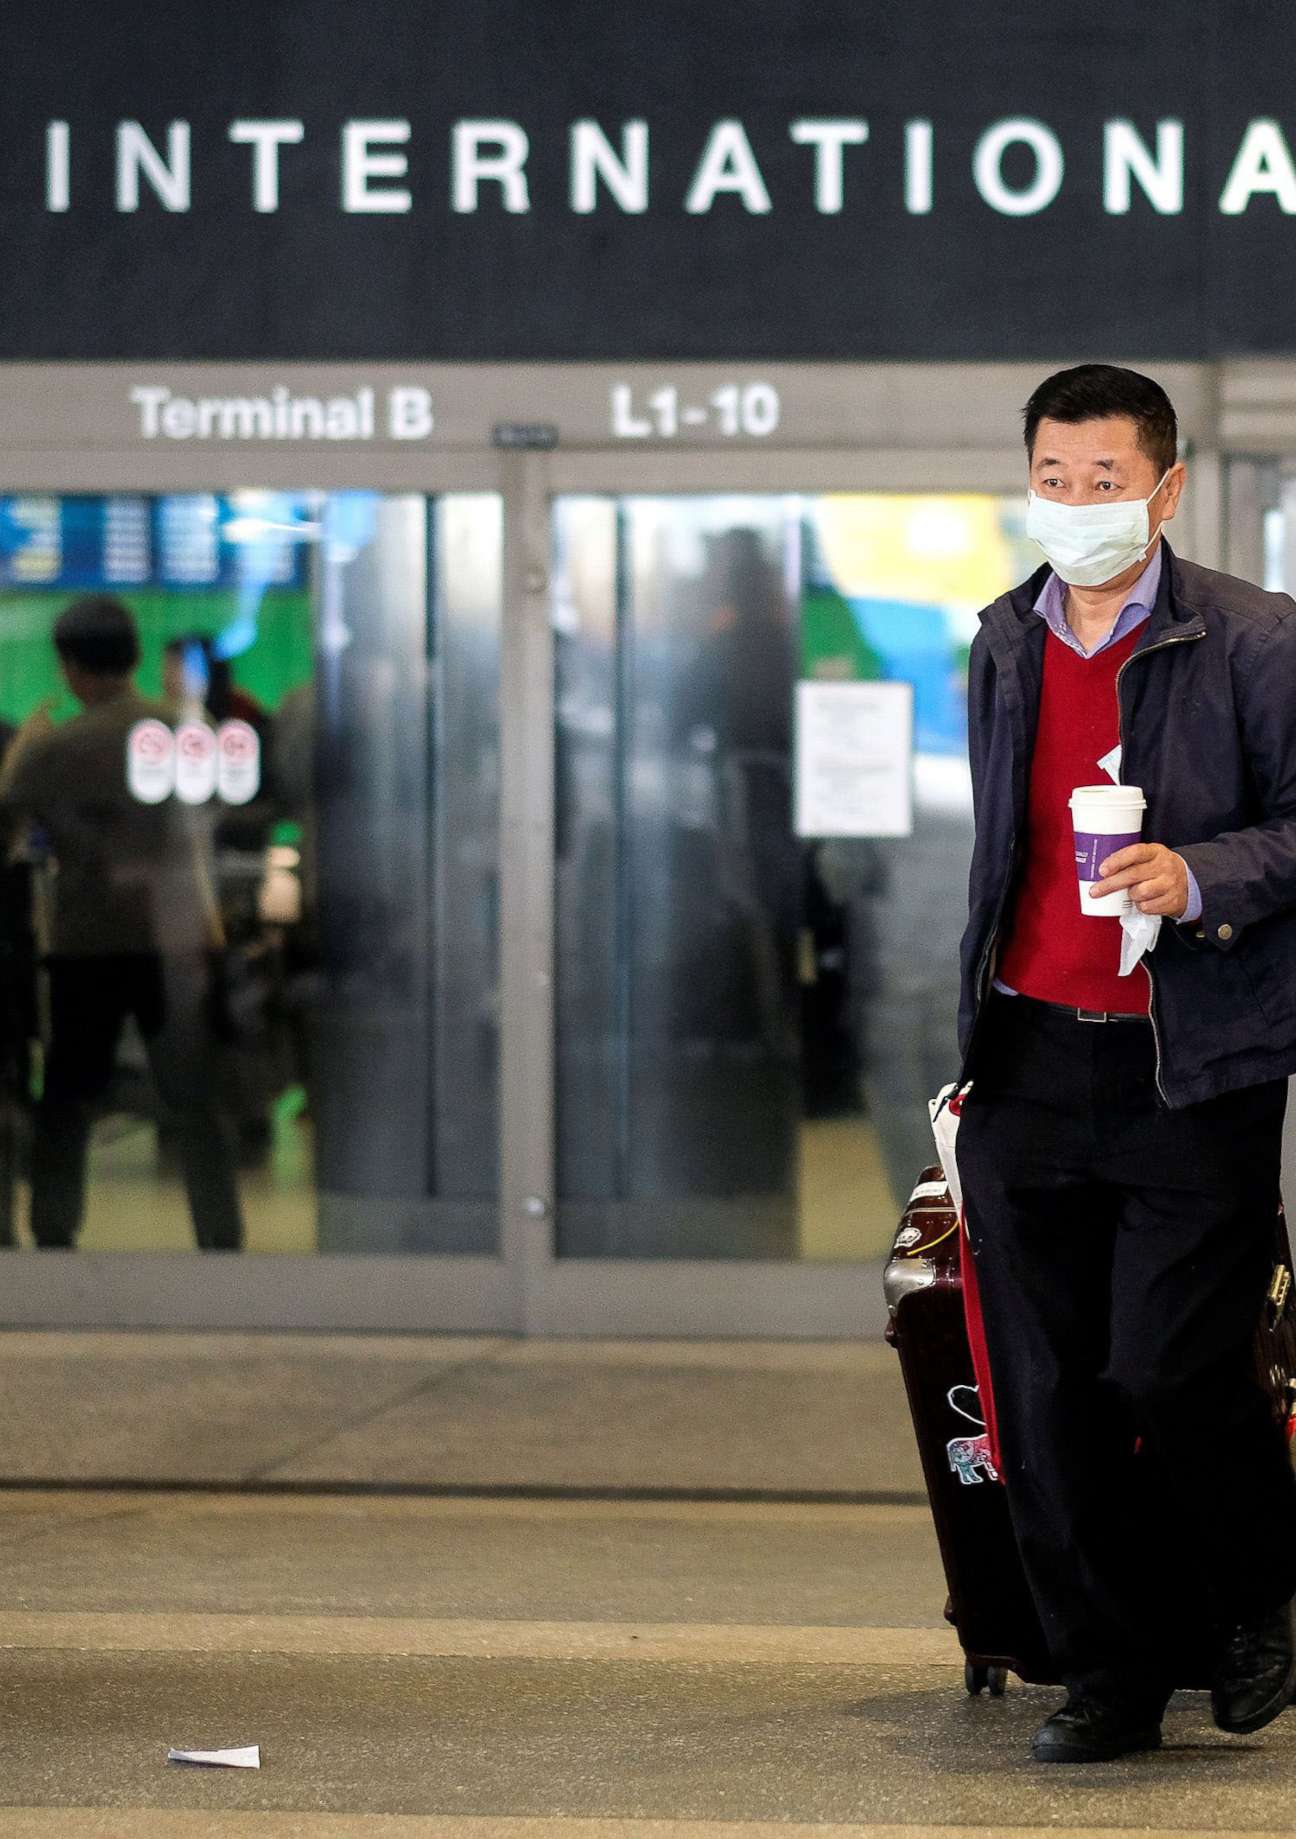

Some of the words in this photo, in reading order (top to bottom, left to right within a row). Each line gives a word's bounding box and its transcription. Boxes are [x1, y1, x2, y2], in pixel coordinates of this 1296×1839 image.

[131, 387, 375, 441] Terminal
[389, 387, 435, 441] B
[611, 383, 781, 438] L1-10
